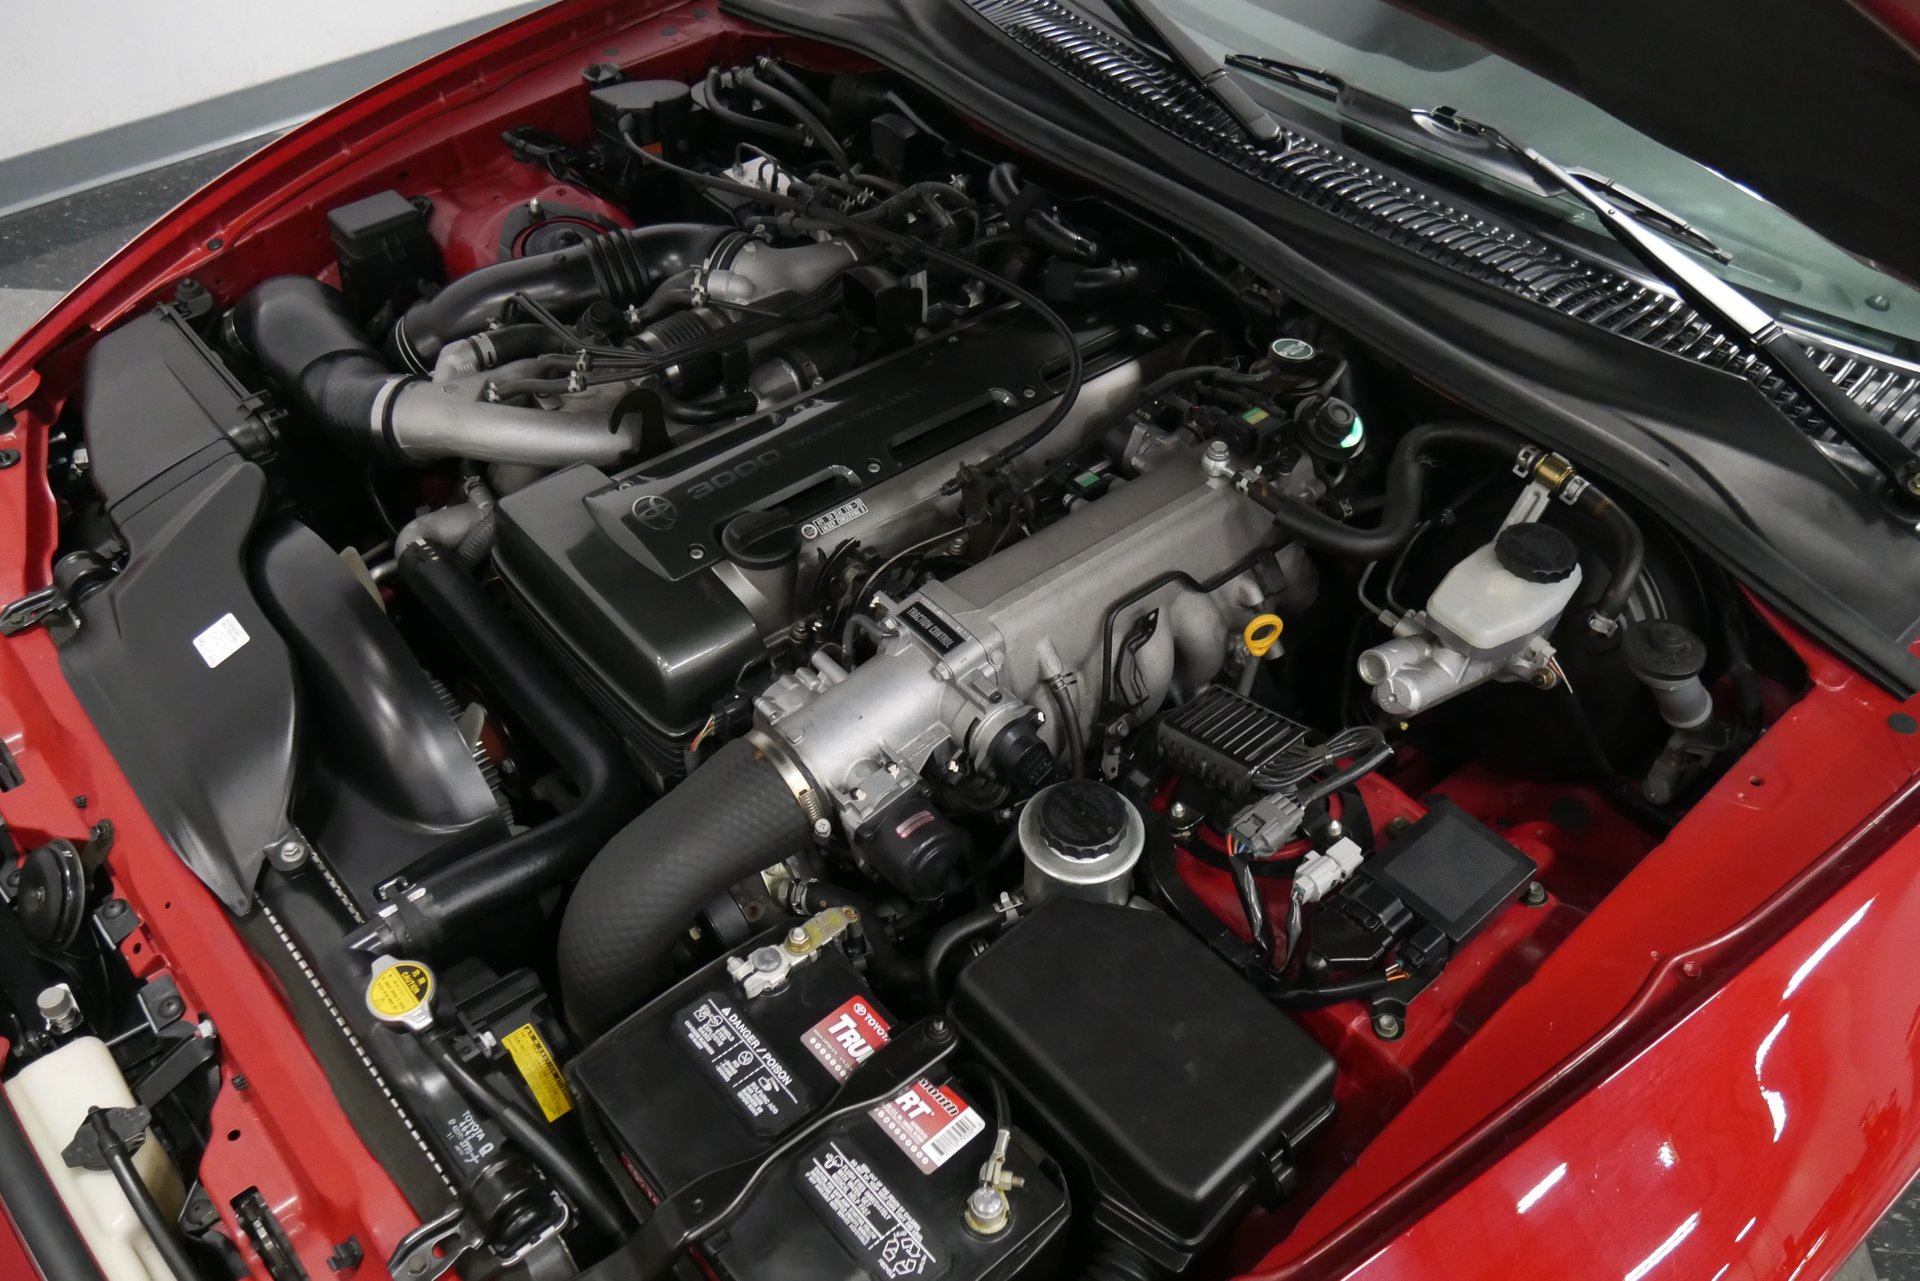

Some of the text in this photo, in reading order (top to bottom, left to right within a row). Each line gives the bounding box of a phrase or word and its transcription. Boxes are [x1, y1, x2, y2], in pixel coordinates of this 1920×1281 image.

[686, 447, 783, 501] 3000
[906, 606, 933, 631] TRACTION
[927, 624, 954, 649] CONTROL
[400, 970, 420, 994] CAUTION
[727, 1012, 760, 1049] DANGER
[761, 1051, 792, 1086] POISON
[460, 1108, 487, 1141] TOYOTA
[840, 1163, 892, 1221] FLUSH EYES IMMEDIATELY
[847, 1191, 861, 1206] HELP
[857, 1202, 871, 1217] FAST
